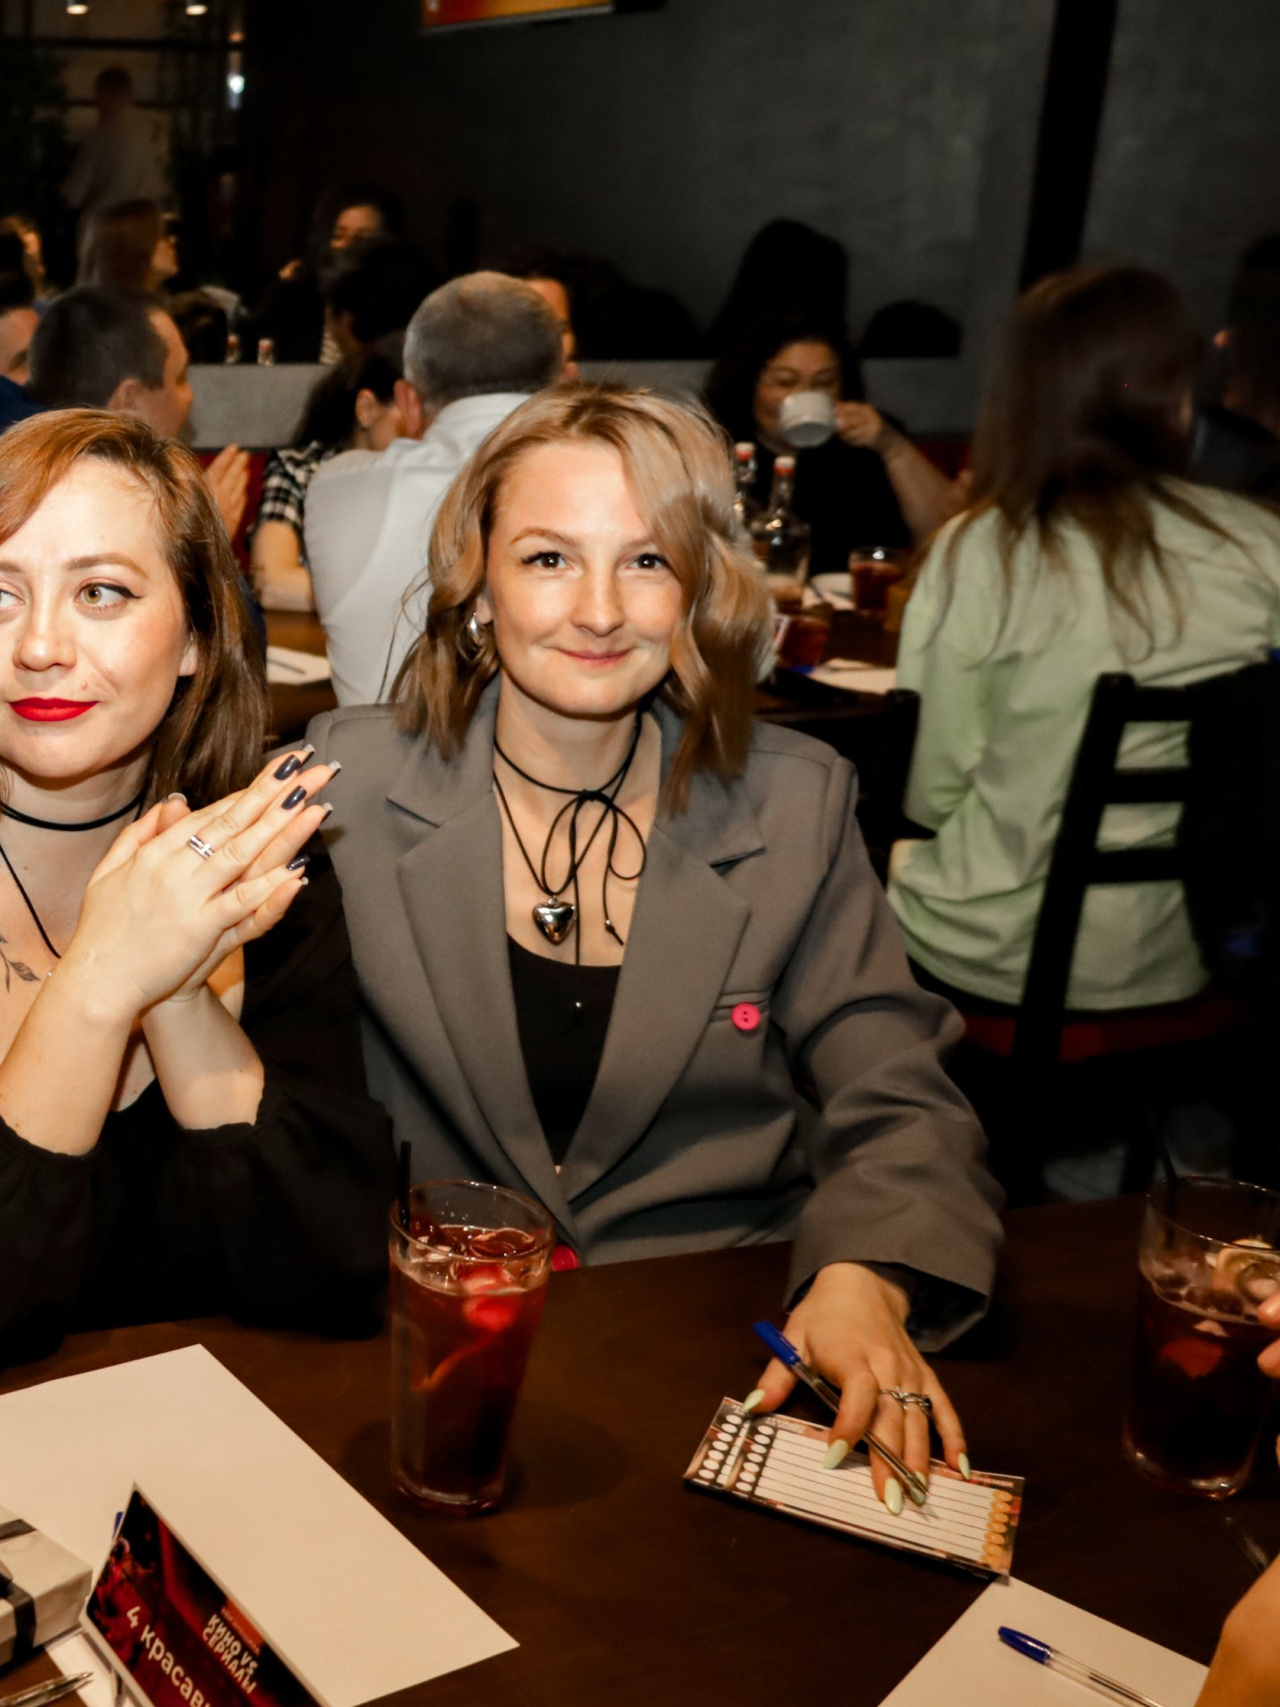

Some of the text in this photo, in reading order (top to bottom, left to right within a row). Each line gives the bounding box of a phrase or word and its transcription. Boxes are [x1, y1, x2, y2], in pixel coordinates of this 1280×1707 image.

[126, 1606, 211, 1707] 4 красав
[202, 1627, 257, 1693] СЕРИАЛЫ
[208, 1614, 241, 1655] КИНО
[240, 1651, 258, 1675] VS
